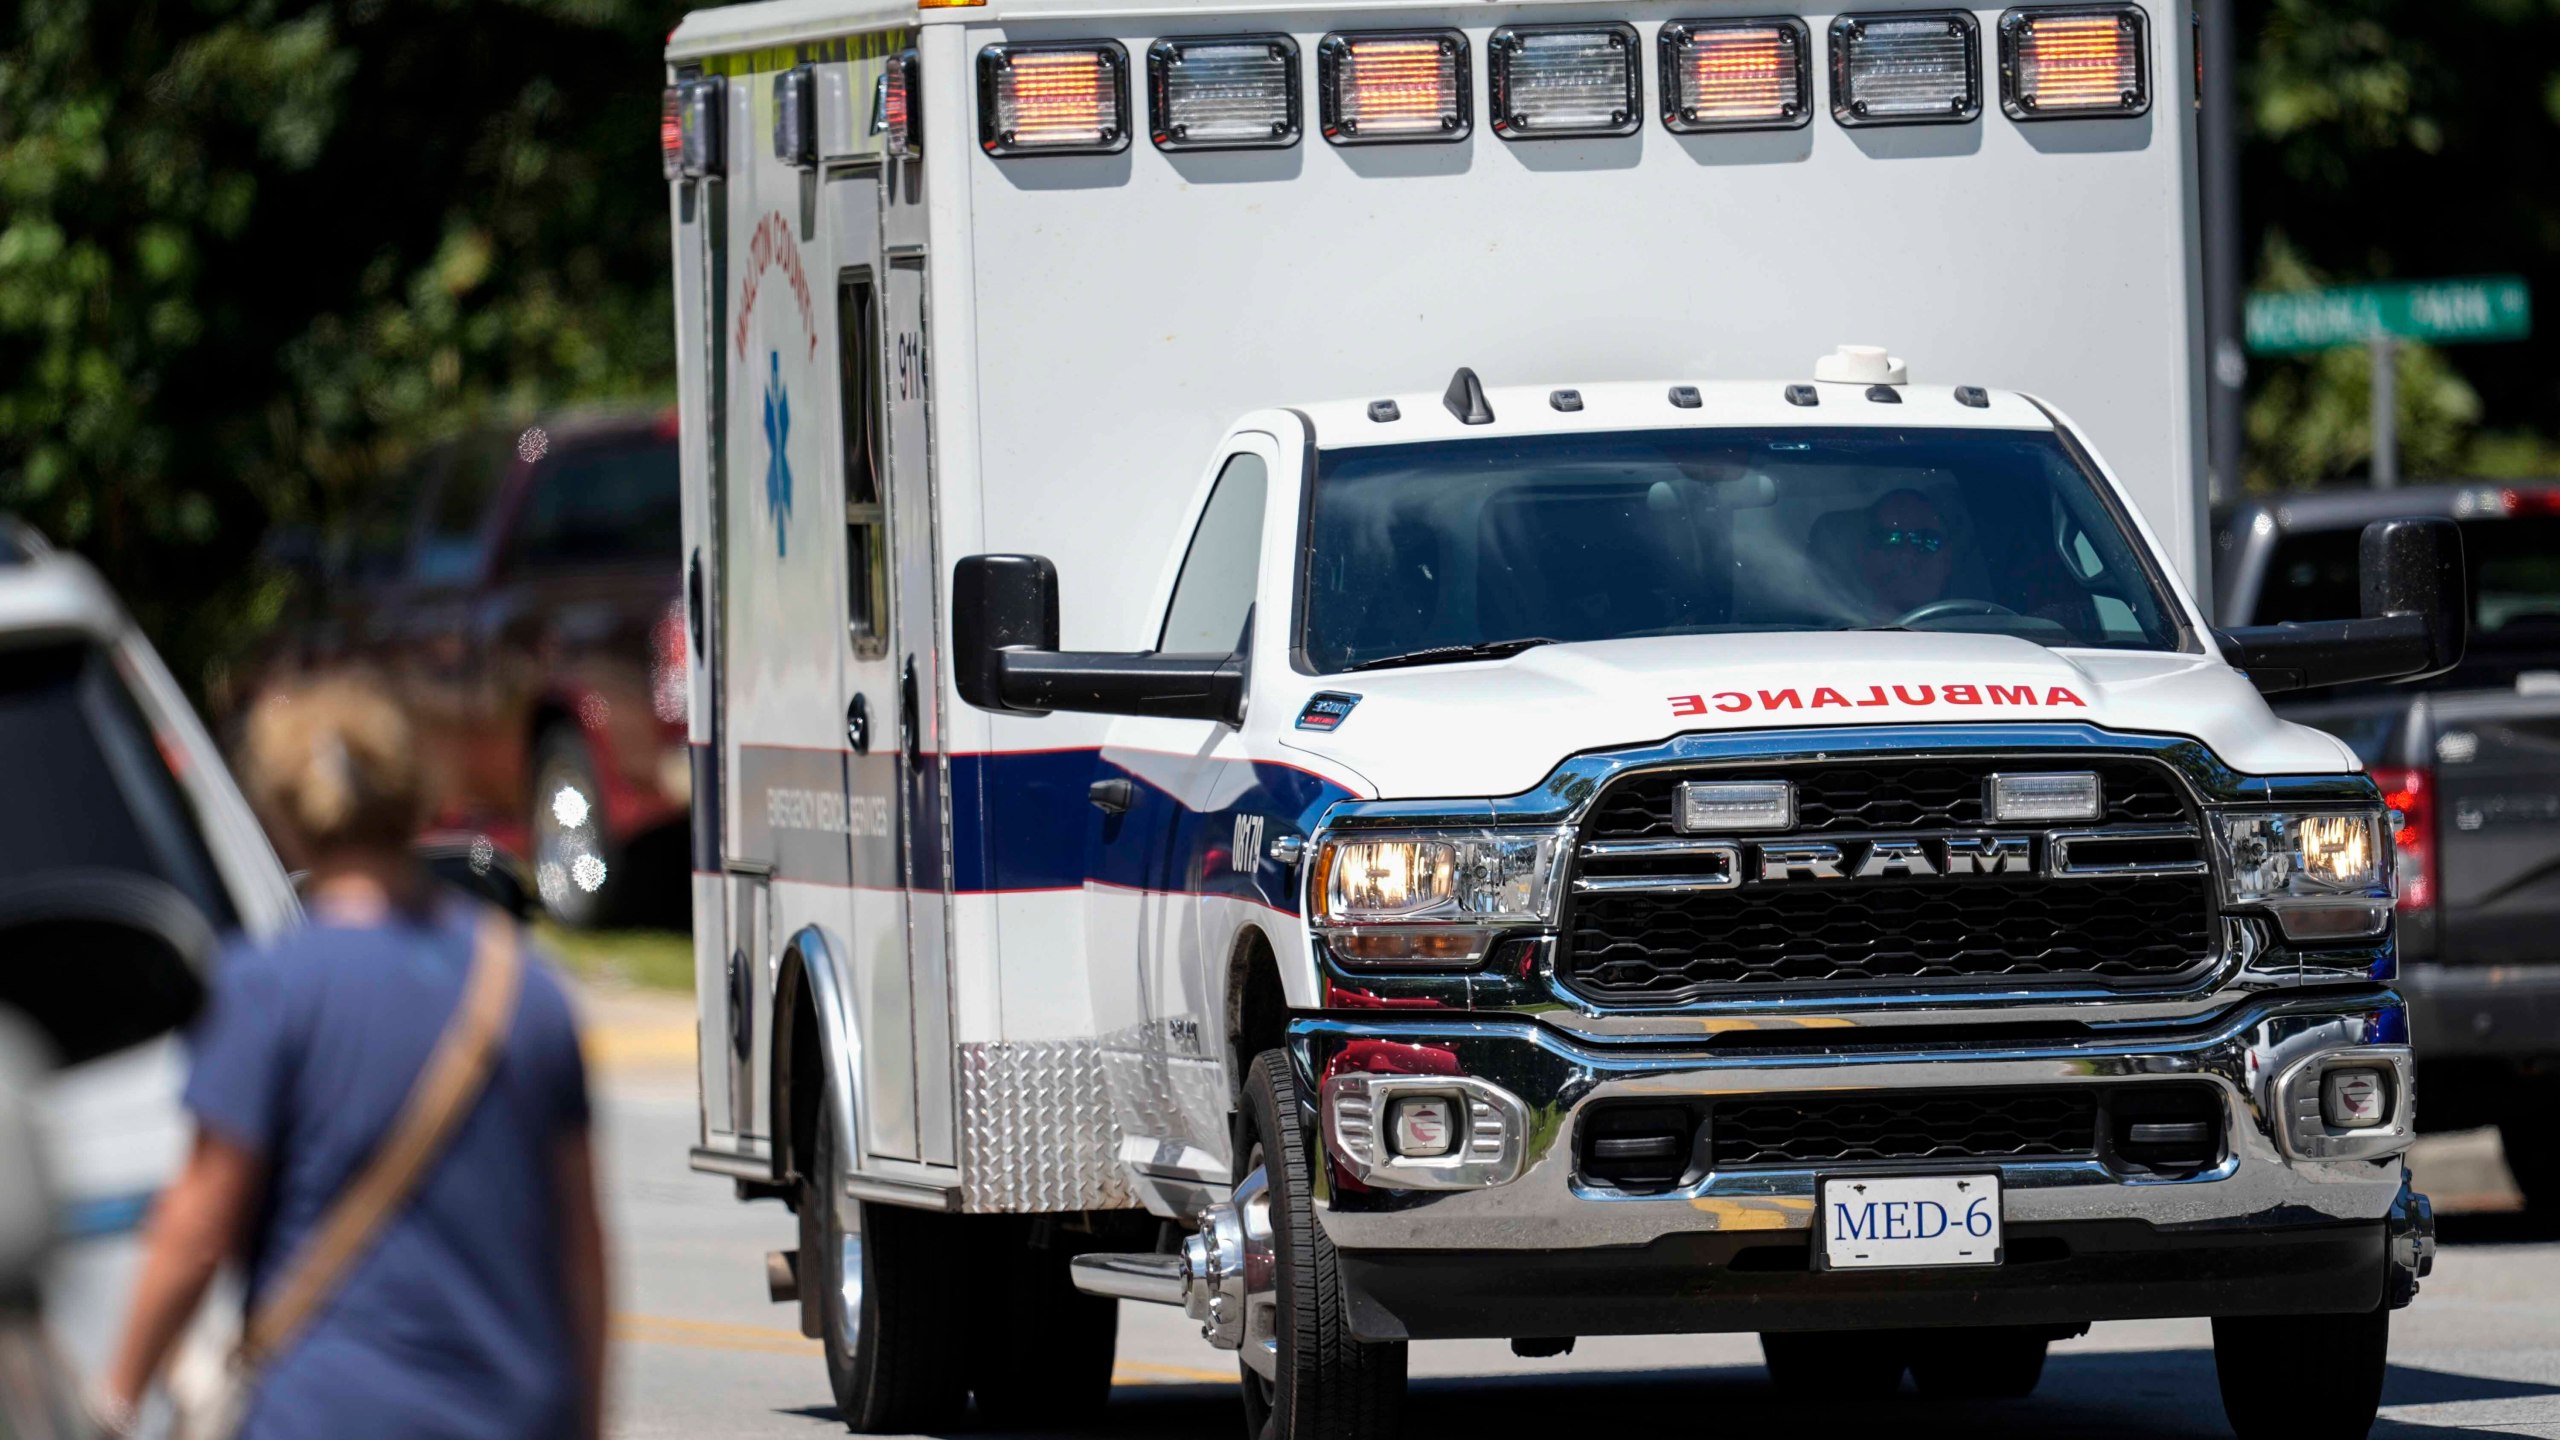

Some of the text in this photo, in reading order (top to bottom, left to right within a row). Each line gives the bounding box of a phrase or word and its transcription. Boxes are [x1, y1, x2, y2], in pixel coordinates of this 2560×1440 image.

[899, 331, 921, 401] 911
[1232, 813, 1264, 874] 08179
[1757, 837, 2031, 880] RAM
[1834, 1197, 1992, 1241] MED-6
